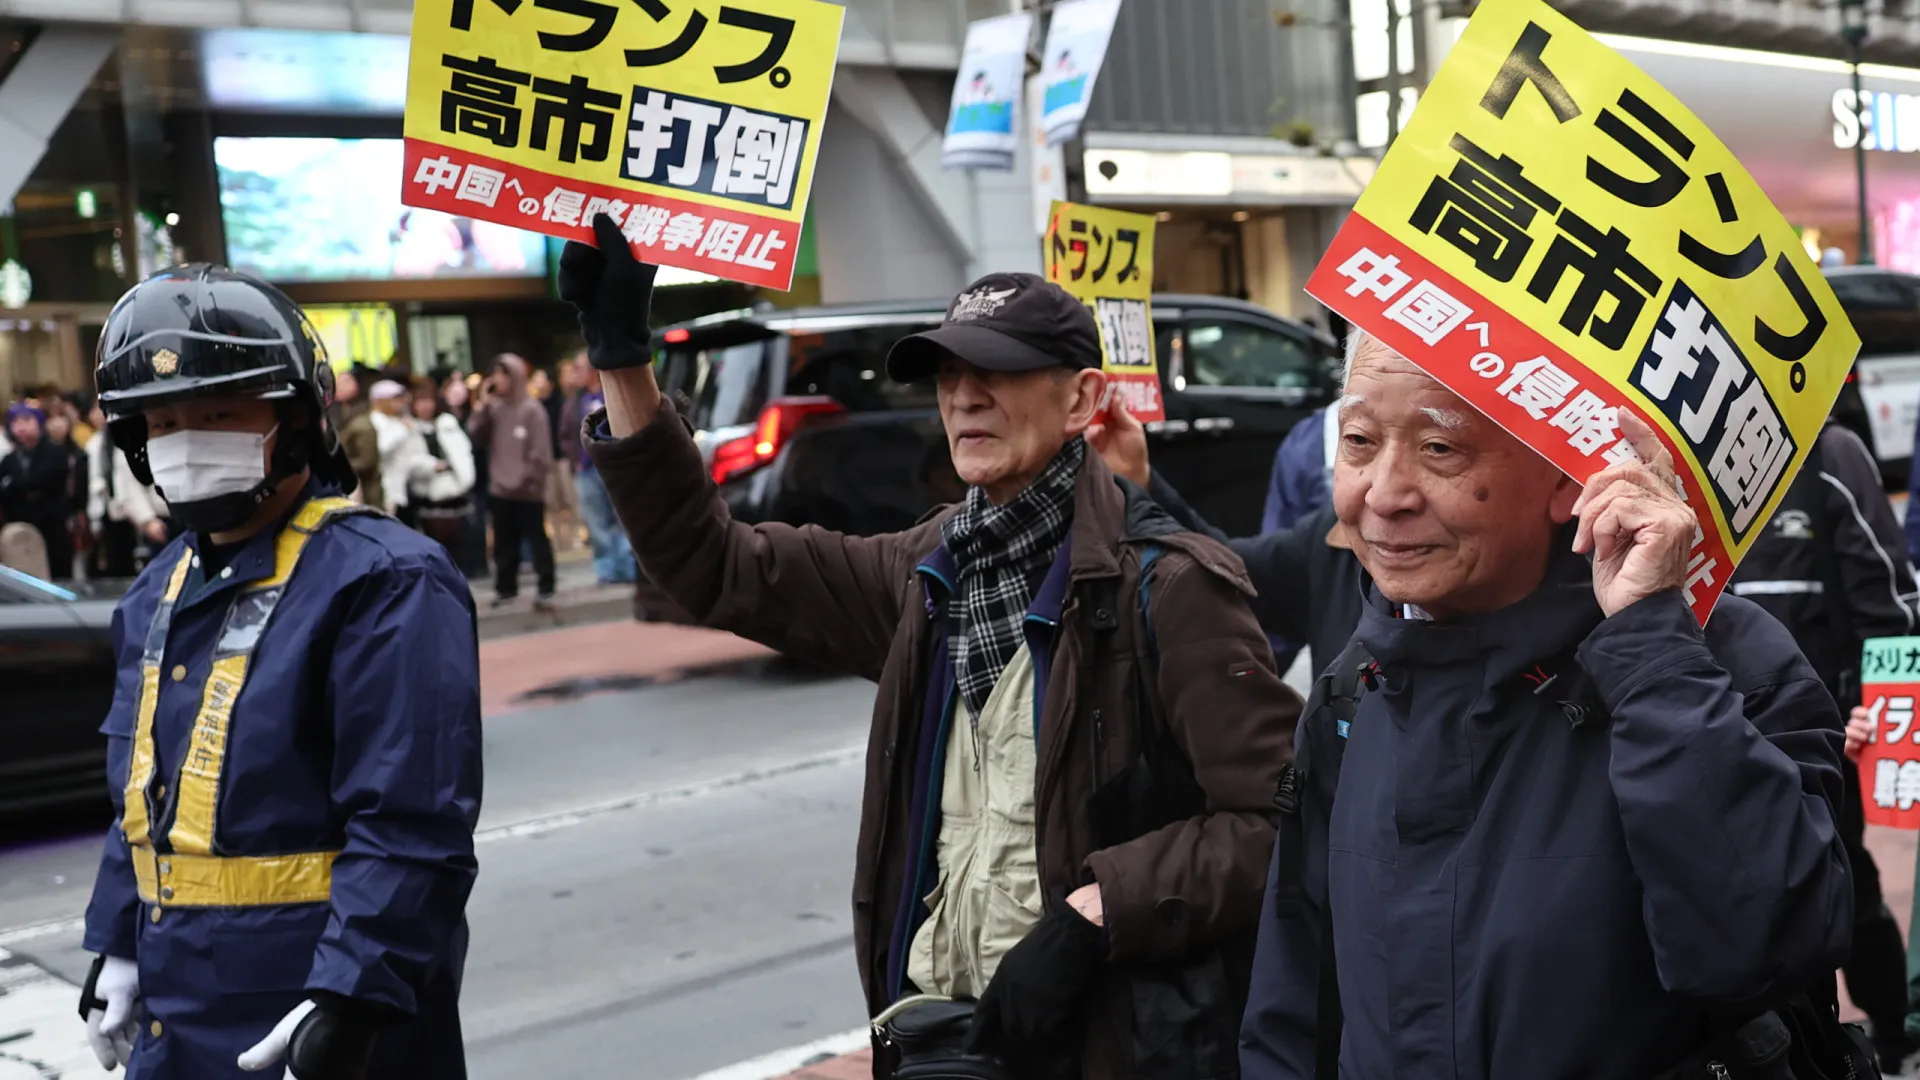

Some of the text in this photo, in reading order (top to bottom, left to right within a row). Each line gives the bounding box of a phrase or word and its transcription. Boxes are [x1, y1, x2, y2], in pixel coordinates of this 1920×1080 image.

[440, 55, 805, 205] 高市打倒
[413, 155, 786, 271] 中国への侵略戦争阻止
[1407, 132, 1792, 535] 高市打倒
[1336, 246, 1717, 606] 中国への侵略止
[1867, 694, 1920, 745] イラ
